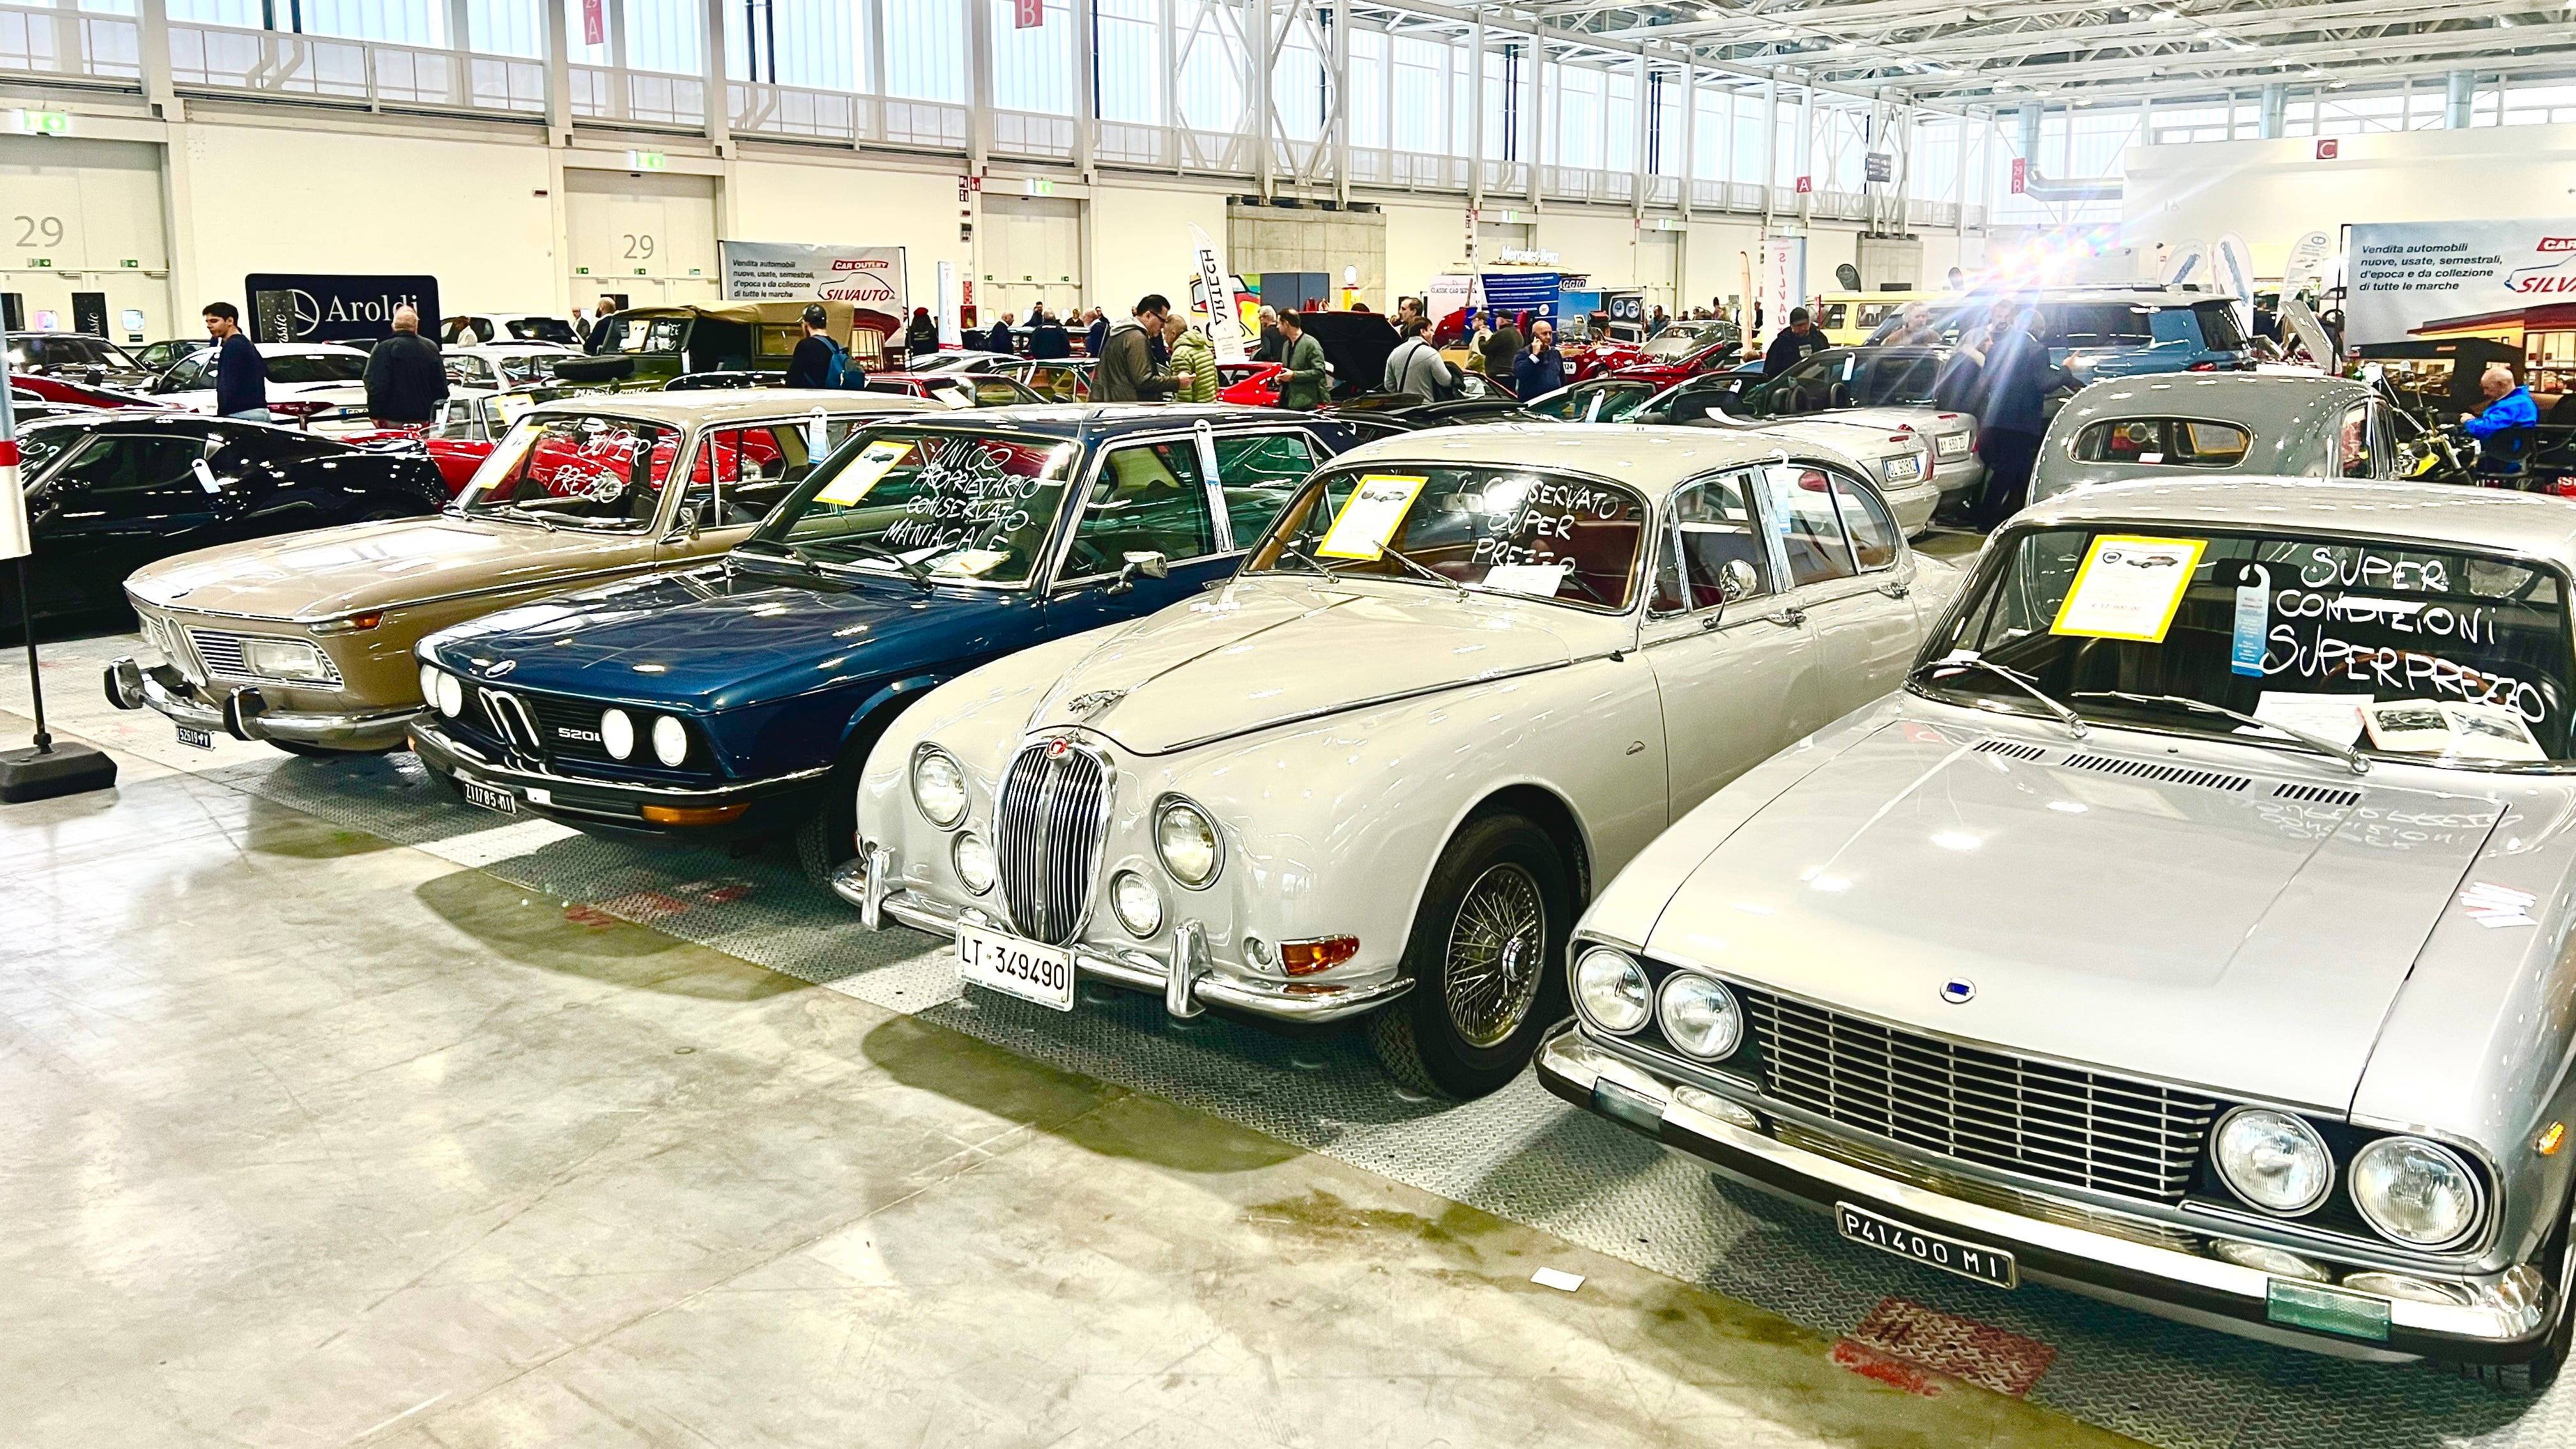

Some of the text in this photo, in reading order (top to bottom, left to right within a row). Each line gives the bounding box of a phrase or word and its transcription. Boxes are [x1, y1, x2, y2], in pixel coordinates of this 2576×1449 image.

[1022, 0, 1036, 27] B
[587, 16, 601, 43] A
[2319, 141, 2335, 158] C
[2013, 165, 2023, 176] 29
[1798, 178, 1810, 192] A
[14, 215, 64, 248] 29
[623, 234, 654, 259] 29
[2362, 243, 2468, 254] Vendita automobili
[2543, 240, 2576, 250] CAR
[732, 259, 758, 267] Vendita
[834, 261, 888, 270] CAR OUTLET
[2360, 255, 2503, 267] nuove, usate, semestrali,
[2359, 270, 2405, 280] d'epoca
[2418, 269, 2432, 278] da
[2435, 268, 2494, 277] collezione
[1559, 280, 1586, 288] AGGIO
[2359, 282, 2460, 291] di tutte le marche
[742, 289, 759, 298] tutte
[823, 289, 890, 301] SILVAUTO
[87, 312, 100, 337] ssic
[275, 313, 289, 344] assic
[1482, 477, 1620, 519] CSERVATO
[906, 494, 1029, 532] CONSERVATO
[2300, 546, 2448, 592] SUPER
[464, 783, 511, 811] Z11785 MI
[962, 935, 1064, 990] LT 349490
[1845, 1213, 1997, 1278] P41400 MI
